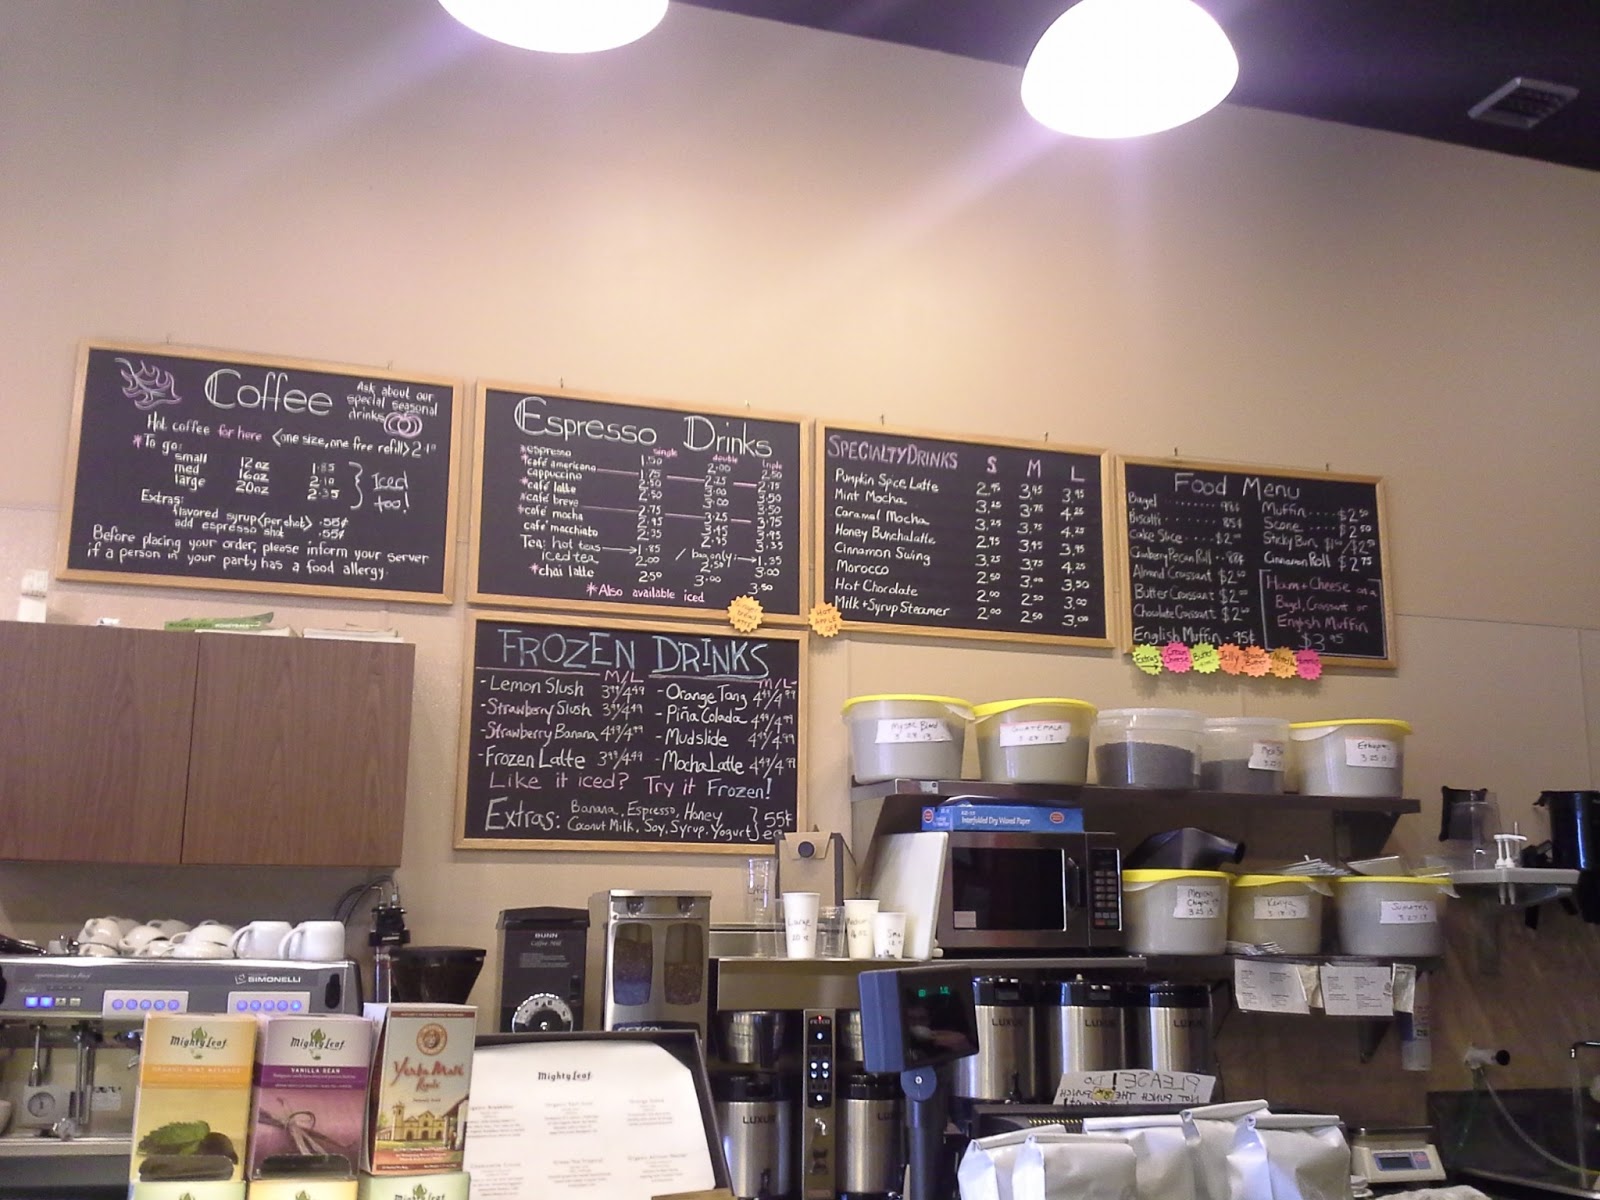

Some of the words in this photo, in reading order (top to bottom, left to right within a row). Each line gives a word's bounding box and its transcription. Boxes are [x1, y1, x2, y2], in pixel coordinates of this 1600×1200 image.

[205, 368, 333, 416] Coffee
[357, 381, 375, 394] Ask
[382, 384, 410, 399] about
[416, 391, 434, 402] our
[347, 393, 385, 408] special
[392, 401, 438, 417] seasonal
[147, 411, 168, 432] Hot
[172, 419, 210, 435] coffee
[217, 424, 235, 439] for
[237, 425, 262, 441] here
[353, 436, 373, 452] free
[514, 396, 657, 446] Espresso
[683, 415, 772, 458] Drinks
[174, 453, 207, 464] small
[526, 445, 572, 458] espresso
[174, 463, 200, 475] med
[371, 470, 409, 491] Iced
[526, 467, 583, 480] cappuccino
[987, 455, 998, 475] S
[1026, 458, 1041, 479] M
[1070, 465, 1085, 482] L
[835, 467, 875, 488] Pumpkin
[878, 473, 907, 492] Spice
[909, 476, 939, 493] Latte
[1174, 472, 1227, 496] Food
[1242, 477, 1300, 501] Menu
[174, 473, 206, 492] large
[373, 491, 410, 514] too!
[834, 488, 860, 502] Mint
[865, 490, 907, 505] Mocha
[172, 504, 219, 519] flavored
[552, 508, 583, 521] mocha
[835, 505, 881, 521] Caramel
[886, 510, 930, 526] Mocha
[1128, 508, 1162, 526] Biscotti
[1262, 501, 1307, 518] Muffin
[174, 518, 193, 528] add
[201, 521, 257, 535] espresso
[263, 526, 284, 538] shot
[835, 522, 868, 543] Honey
[1263, 516, 1304, 532] Scone
[93, 523, 136, 543] Before
[142, 532, 181, 553] placing
[189, 538, 217, 551] your
[262, 542, 299, 556] please
[306, 540, 348, 558] inform
[354, 549, 382, 561] your
[387, 552, 430, 564] server
[552, 535, 573, 549] hot
[578, 540, 601, 552] teas
[1129, 528, 1155, 543] Cake
[1157, 528, 1183, 544] Slice
[1294, 535, 1318, 549] Bun
[87, 541, 102, 558] if
[105, 548, 113, 559] a
[120, 547, 161, 563] person
[167, 549, 178, 560] in
[187, 553, 216, 566] your
[222, 554, 257, 571] party
[261, 557, 283, 570] has
[292, 561, 300, 572] a
[306, 559, 334, 574] food
[541, 549, 571, 561] iced
[573, 551, 599, 564] tea
[834, 541, 892, 558] Cinnamon
[895, 546, 931, 566] Swing
[1308, 551, 1331, 568] Roll
[538, 566, 563, 578] chai
[569, 565, 595, 578] latte
[836, 559, 890, 575] Morocco
[835, 577, 861, 590] Hot
[1134, 583, 1169, 600] Butter
[1309, 576, 1351, 593] Cheese
[632, 586, 676, 599] available
[683, 589, 705, 602] iced
[834, 595, 860, 610] Milk
[900, 600, 951, 617] Steamer
[1325, 616, 1369, 633] Muffin
[1133, 626, 1180, 645] English
[1182, 626, 1222, 646] Muffin
[497, 629, 635, 670] FROZEN
[652, 635, 769, 679] DRINKS
[490, 675, 541, 694] Lemon
[545, 677, 584, 697] Slush
[666, 683, 716, 709] Orange
[717, 683, 748, 711] Tang
[487, 697, 555, 725] Strawberry
[556, 700, 592, 717] Slush
[666, 704, 700, 725] Piña
[701, 706, 748, 725] Colada
[485, 721, 552, 747] Strawberry
[554, 722, 599, 742] Banana
[664, 727, 729, 747] Mudslide
[485, 745, 535, 768] Frozen
[539, 747, 586, 769] Latte
[489, 771, 542, 789] Like
[556, 771, 568, 789] it
[578, 771, 630, 791] iced?
[643, 775, 675, 798] Try
[682, 776, 696, 796] it
[707, 777, 772, 800] Frozen!
[484, 796, 561, 832] Extras:
[684, 801, 723, 827] Honey
[567, 815, 607, 832] Coconut
[710, 822, 751, 841] Yogurt
[248, 975, 302, 983] SIMONELLI
[170, 1035, 204, 1049] Mighty
[290, 1036, 324, 1049] Mighty
[537, 1071, 571, 1082] Mighty
